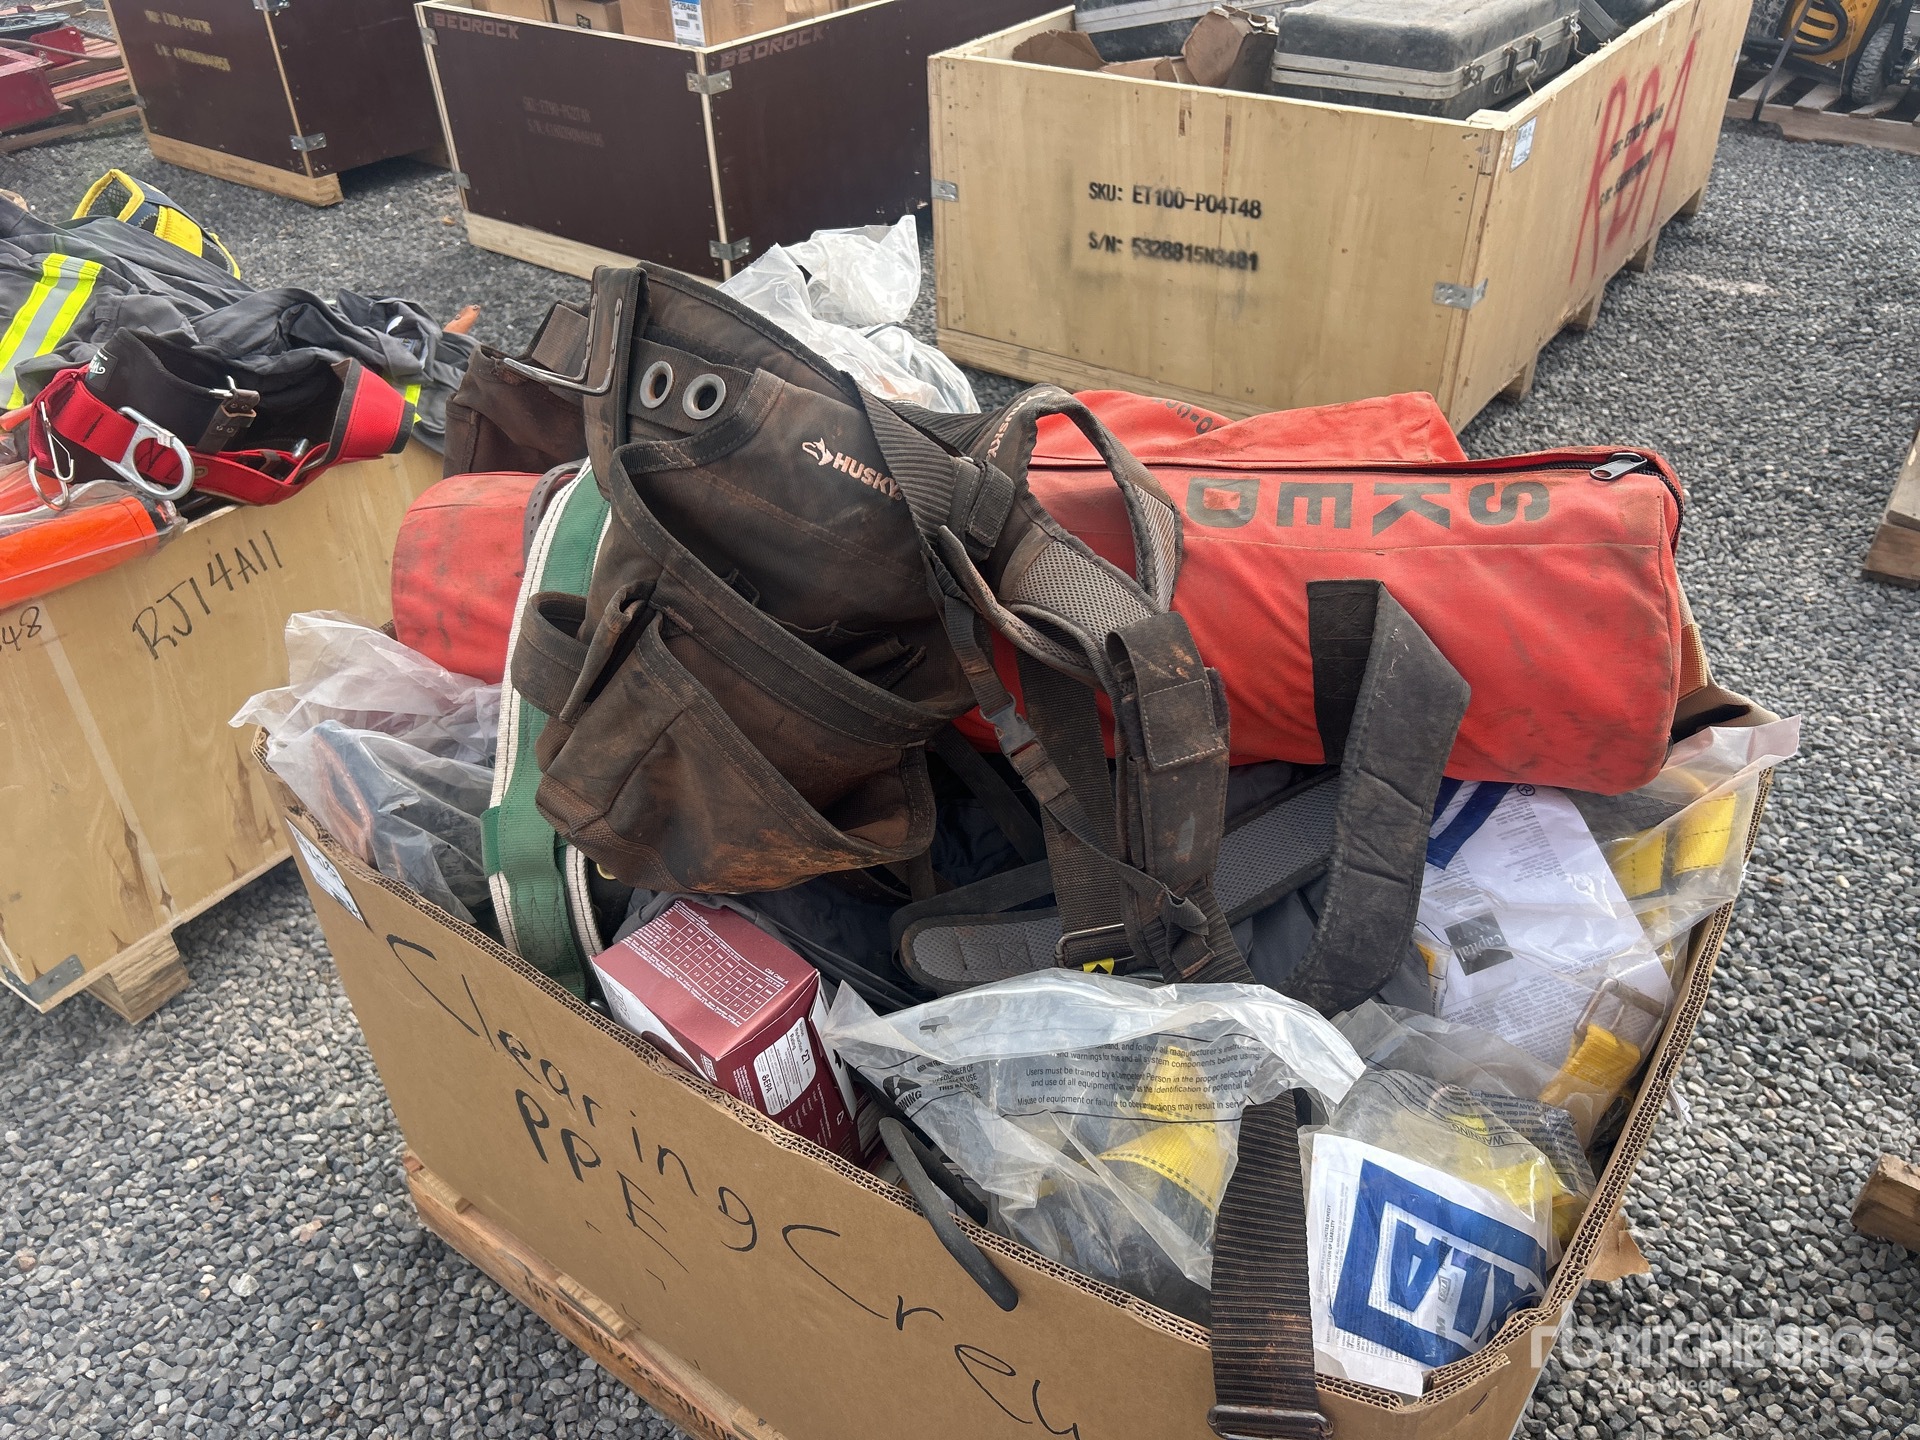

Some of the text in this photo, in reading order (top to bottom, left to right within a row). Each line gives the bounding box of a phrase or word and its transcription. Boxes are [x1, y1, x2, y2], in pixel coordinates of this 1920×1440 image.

[433, 12, 519, 41] BEDROCK
[720, 28, 826, 69] BEDROCK
[1089, 181, 1262, 219] SKU: ET100-P04T48
[1088, 231, 1123, 253] S/N:
[1186, 476, 1550, 536] SKED
[0, 606, 42, 652] 48
[1456, 934, 1503, 962] capital
[799, 1049, 811, 1064] 27
[1071, 1052, 1101, 1061] warnings
[1143, 1057, 1169, 1065] system
[1171, 1058, 1218, 1066] components
[1026, 1068, 1042, 1076] Users
[1064, 1066, 1072, 1074] be
[1075, 1068, 1099, 1077] trained
[1101, 1070, 1110, 1078] by
[1146, 1073, 1170, 1082] Person
[1195, 1074, 1217, 1083] proper
[1031, 1078, 1042, 1086] and
[1058, 1077, 1065, 1085] of
[1067, 1077, 1075, 1085] all
[1077, 1080, 1117, 1090] equipment,
[1212, 1082, 1242, 1091] potential
[386, 934, 760, 1252] Clearing
[763, 1079, 773, 1093] EPA
[898, 1091, 922, 1109] NING
[1037, 1095, 1045, 1103] of
[1046, 1095, 1083, 1103] equipment
[1095, 1097, 1117, 1106] failure
[1178, 1104, 1192, 1112] may
[1451, 1123, 1505, 1146] WARNING
